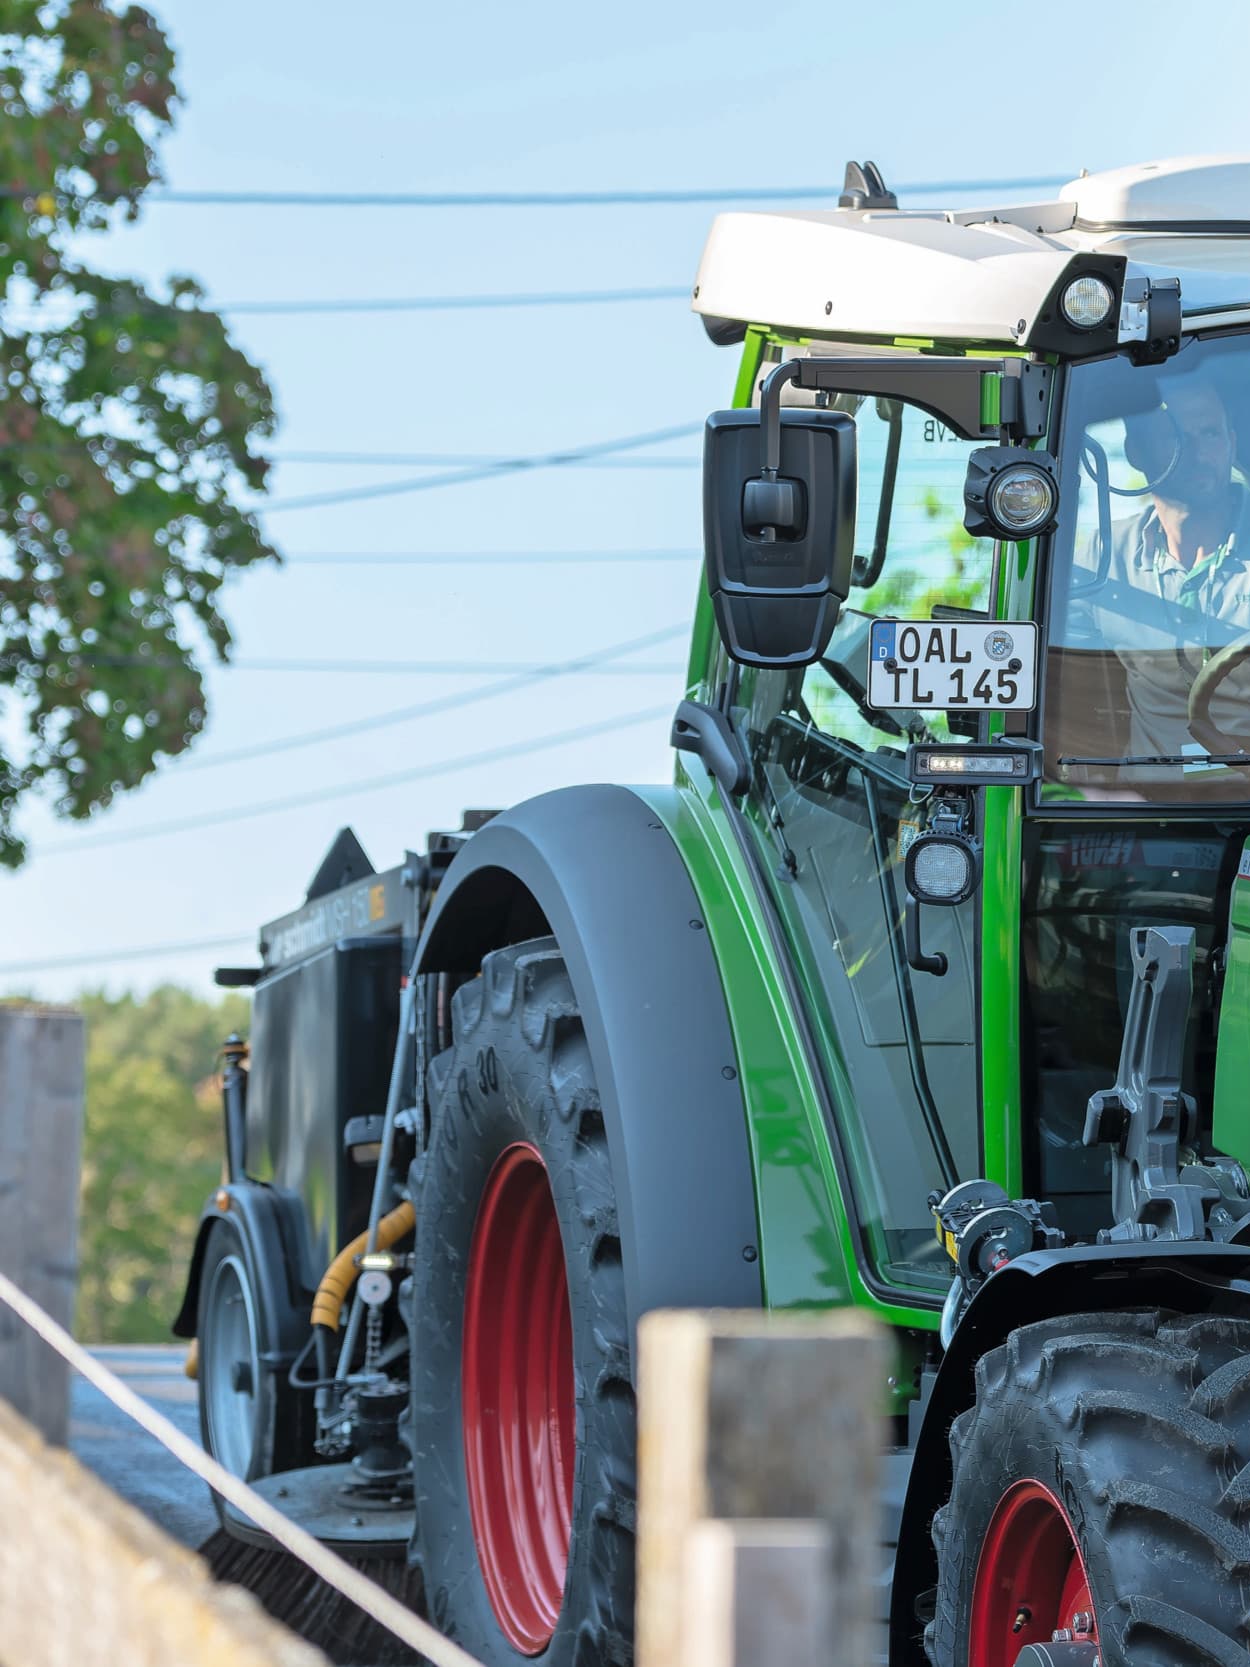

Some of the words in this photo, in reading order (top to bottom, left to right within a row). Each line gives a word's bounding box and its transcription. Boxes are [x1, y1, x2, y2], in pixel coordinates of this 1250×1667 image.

[879, 646, 888, 658] D
[899, 626, 972, 664] OAL
[886, 667, 934, 703] TL
[948, 668, 1018, 704] 145
